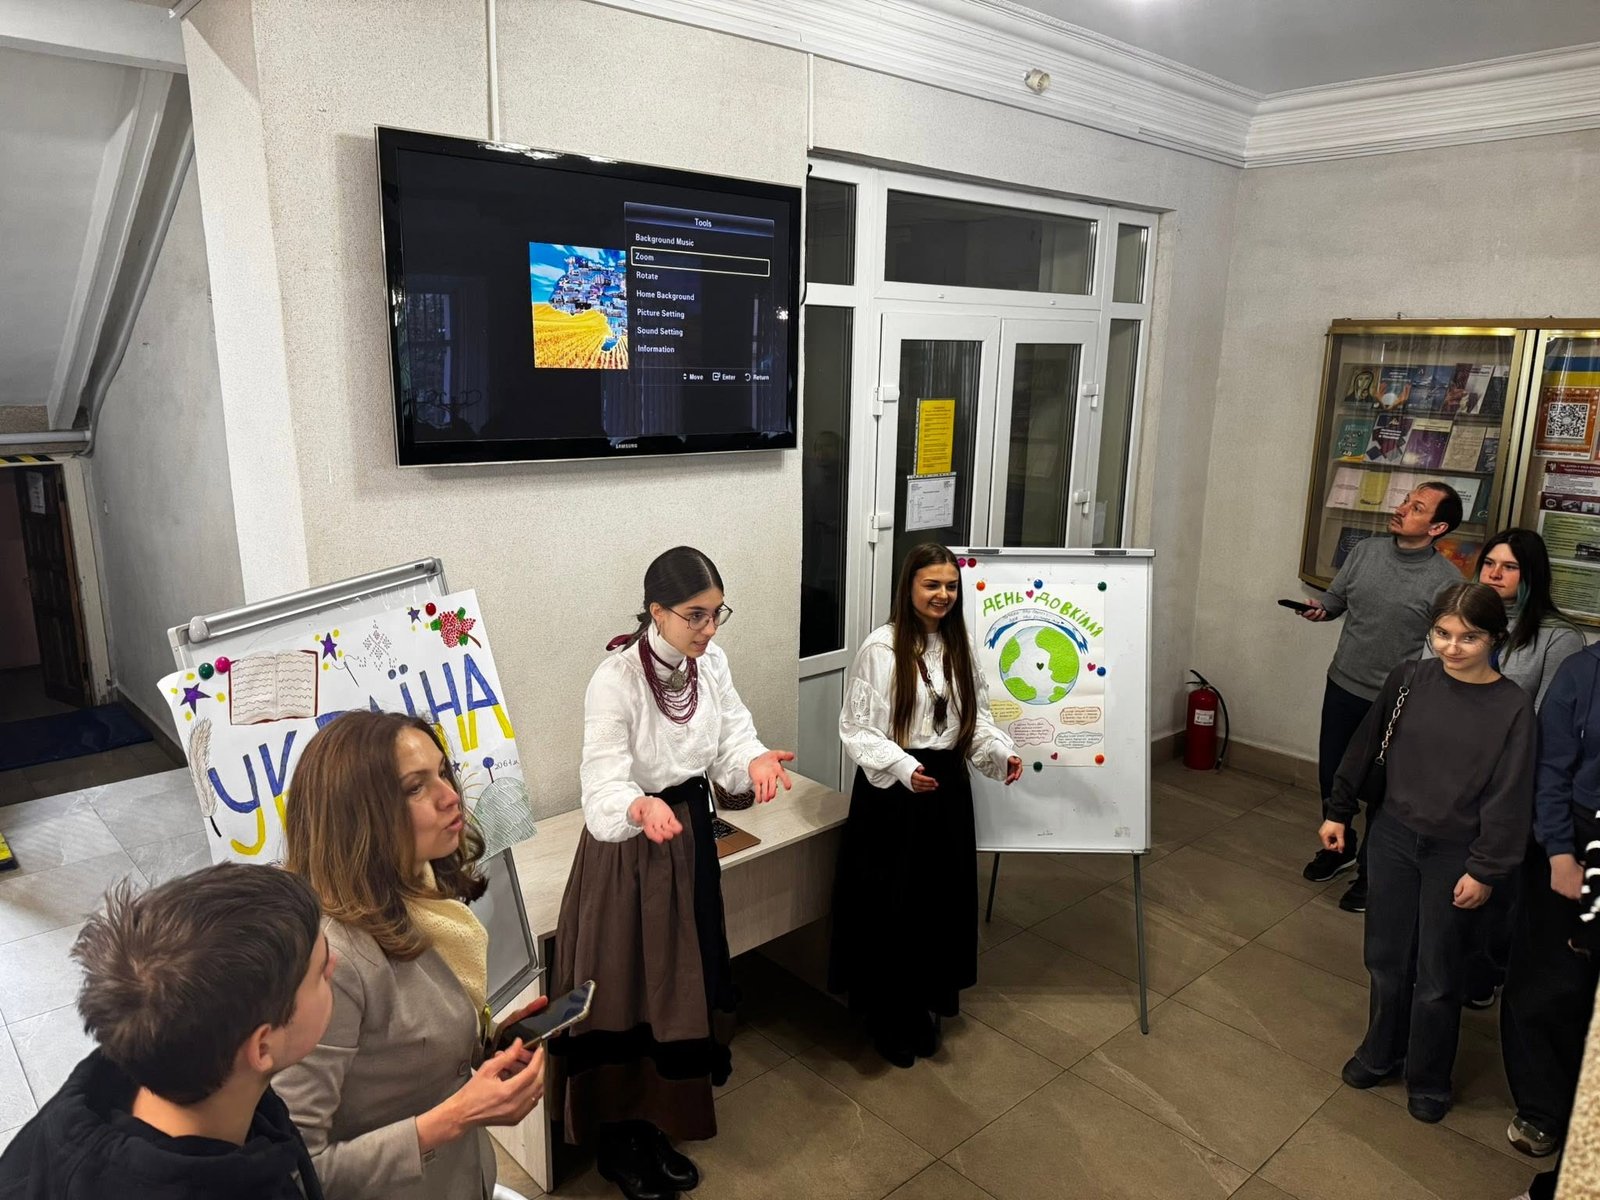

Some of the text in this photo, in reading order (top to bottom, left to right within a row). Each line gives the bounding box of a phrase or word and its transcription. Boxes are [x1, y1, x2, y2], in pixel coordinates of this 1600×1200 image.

[694, 217, 712, 228] Tools
[635, 233, 695, 247] Background Music
[635, 252, 654, 261] Zoom
[636, 271, 659, 280] Rotate
[636, 290, 695, 301] Home Background
[637, 308, 685, 320] Picture Setting
[637, 326, 684, 338] Sound Setting
[637, 345, 675, 353] Information
[983, 591, 1024, 617] ДЕНЬ
[1034, 591, 1104, 638] ДОВКІЛЛЯ
[207, 653, 515, 856] УКЇНА
